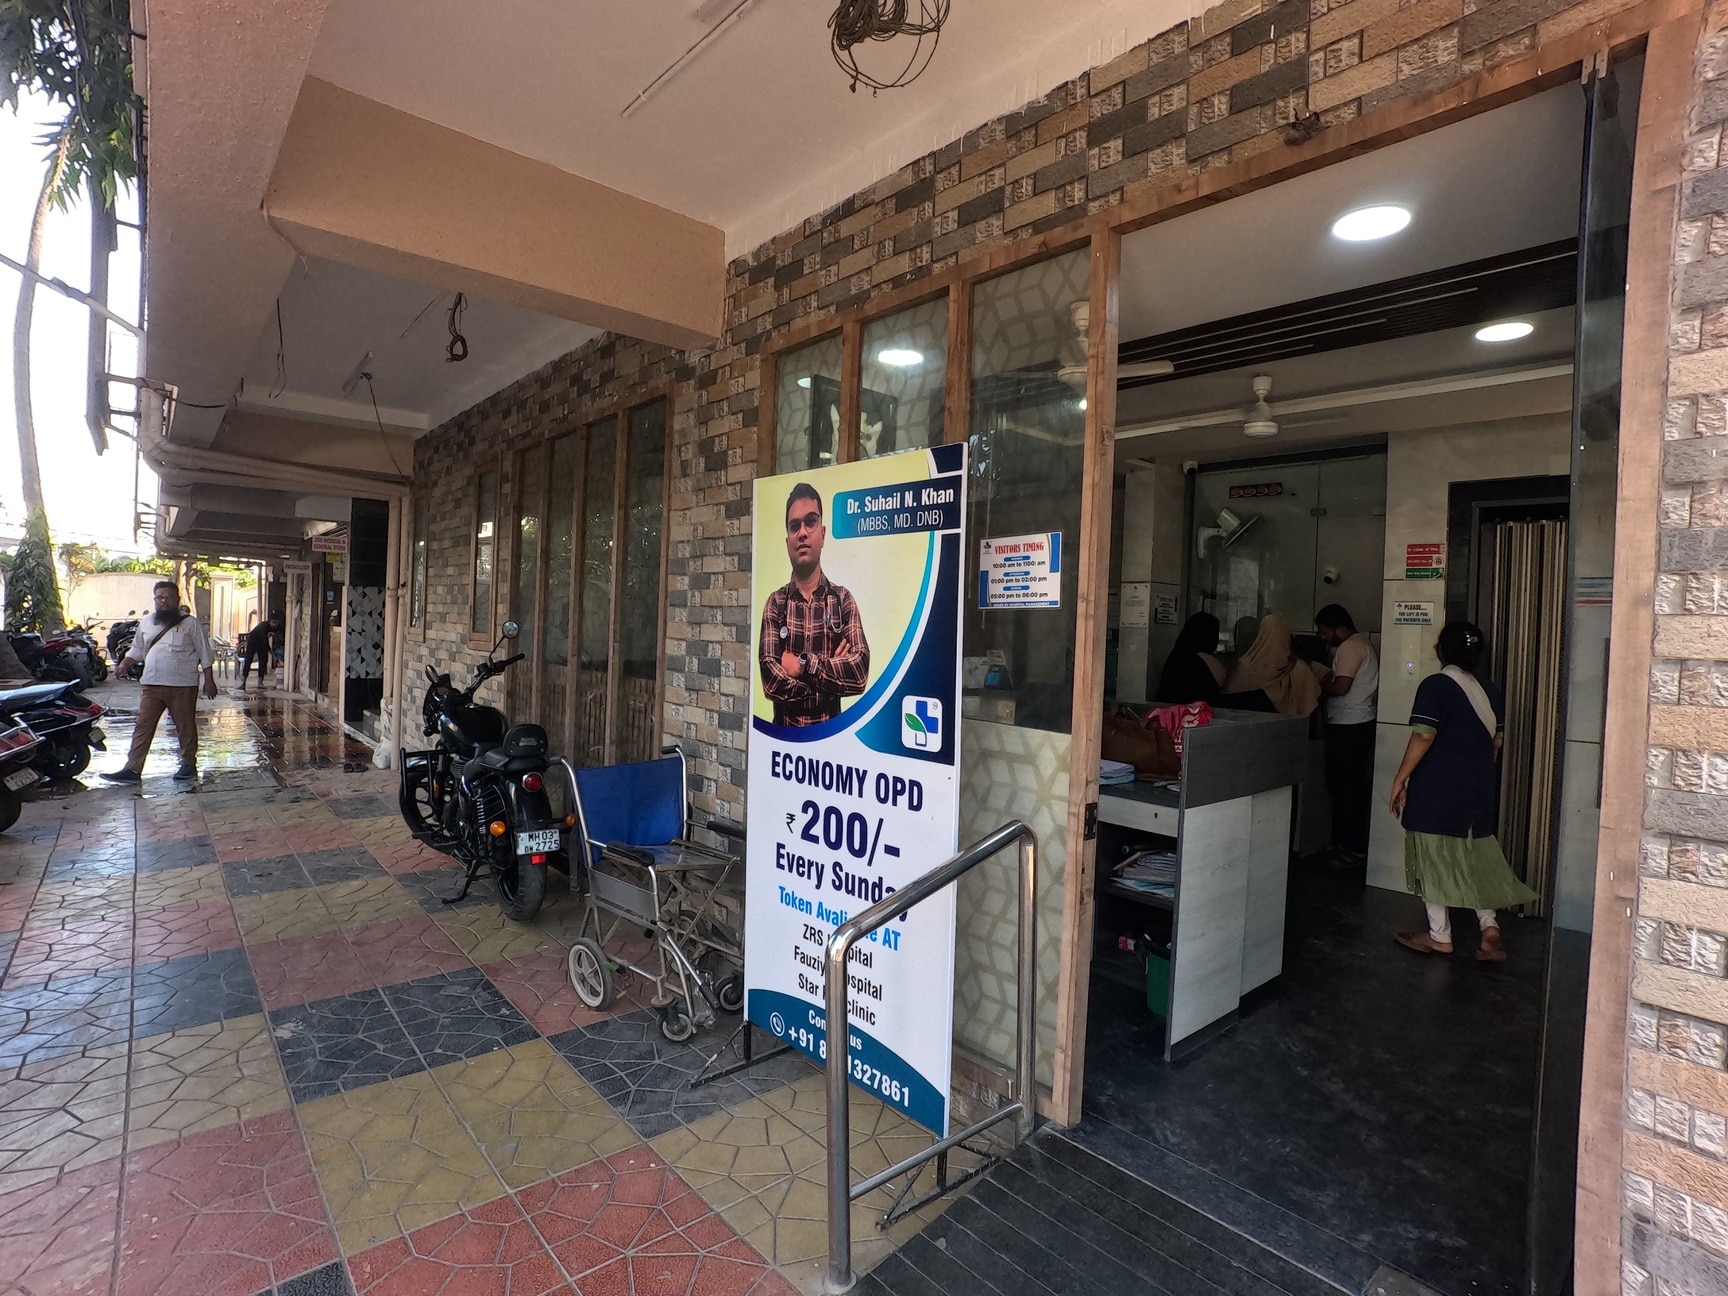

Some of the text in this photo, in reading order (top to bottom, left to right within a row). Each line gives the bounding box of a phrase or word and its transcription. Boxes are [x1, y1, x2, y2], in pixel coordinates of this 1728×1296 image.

[847, 487, 954, 514] Dr. Suhail N. Khan
[857, 509, 944, 535] (MBBS, MD. DNB)
[995, 541, 1044, 554] VISITORS TIMING
[771, 750, 923, 812] ECONOMY OPD
[535, 839, 559, 852] 2725
[776, 842, 825, 890] Every
[779, 885, 813, 916] Token
[882, 927, 901, 952] AT
[803, 923, 824, 947] ZRS
[798, 972, 819, 997] Star
[849, 1034, 863, 1051] us
[788, 1026, 909, 1108] +91 81327861
